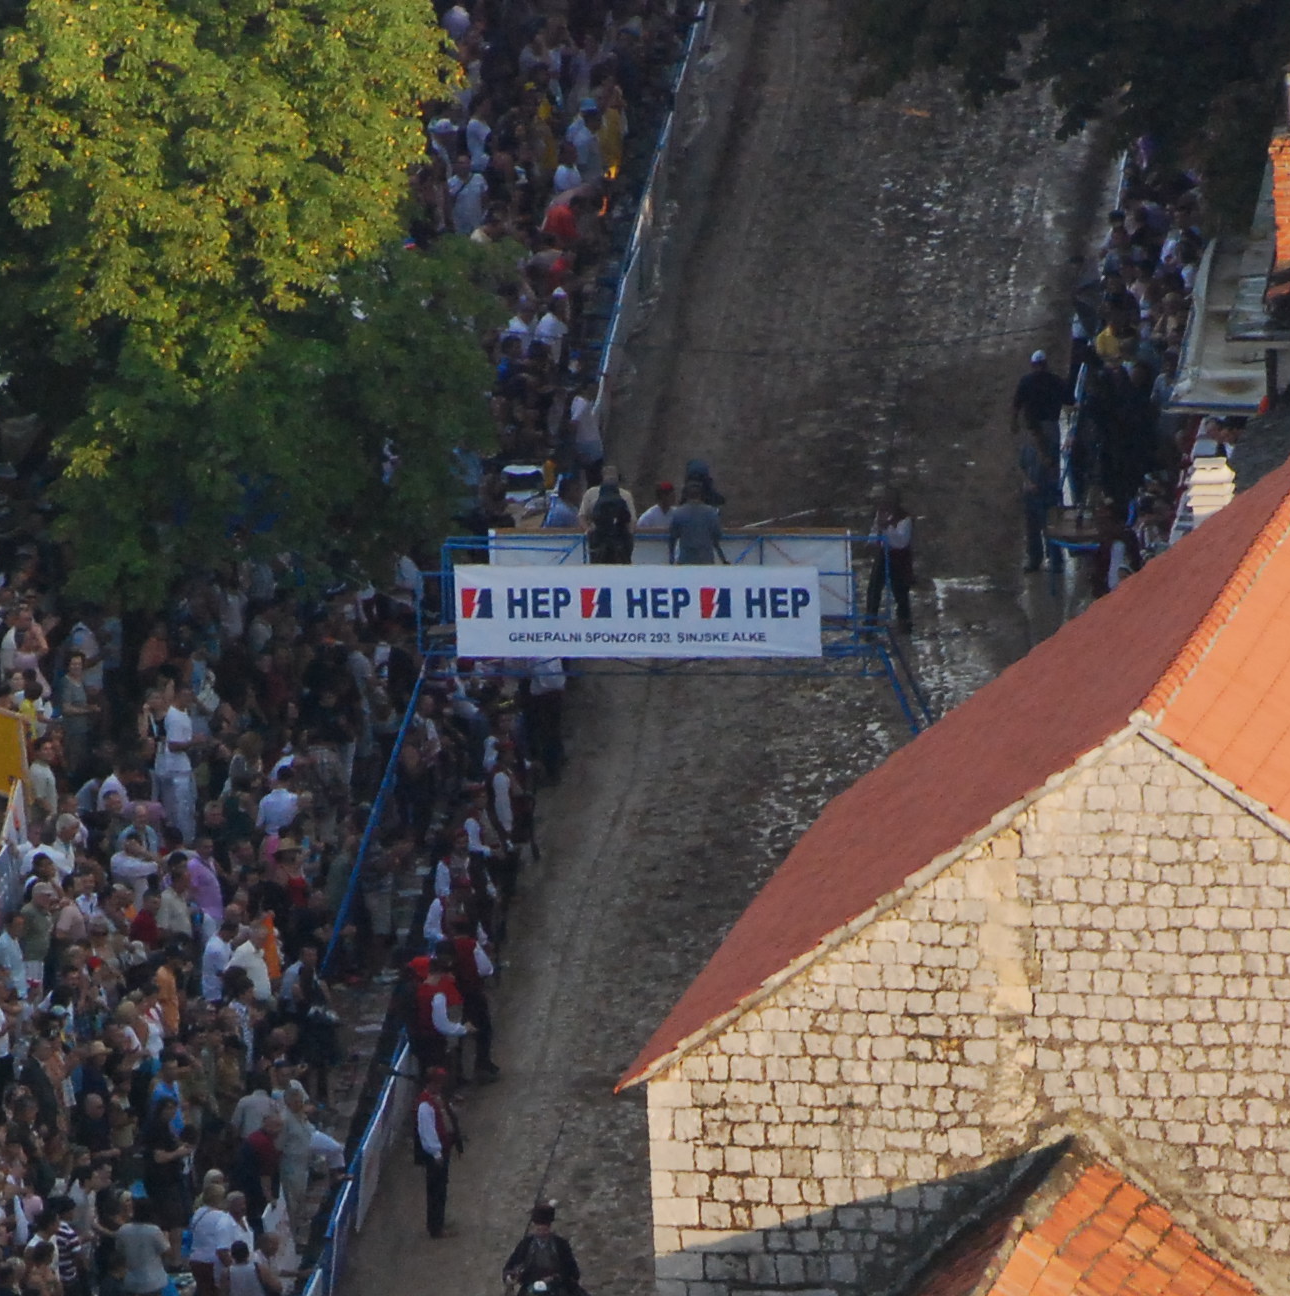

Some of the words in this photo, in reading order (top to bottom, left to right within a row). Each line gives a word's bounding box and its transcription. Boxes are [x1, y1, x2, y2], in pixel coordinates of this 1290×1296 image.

[507, 587, 572, 619] HEP
[626, 587, 691, 619] HEP
[745, 587, 811, 619] HEP
[508, 631, 582, 643] GENERALNI
[584, 631, 647, 643] SPONZOR
[676, 631, 730, 643] SINJSKE
[731, 631, 767, 643] ALKE
